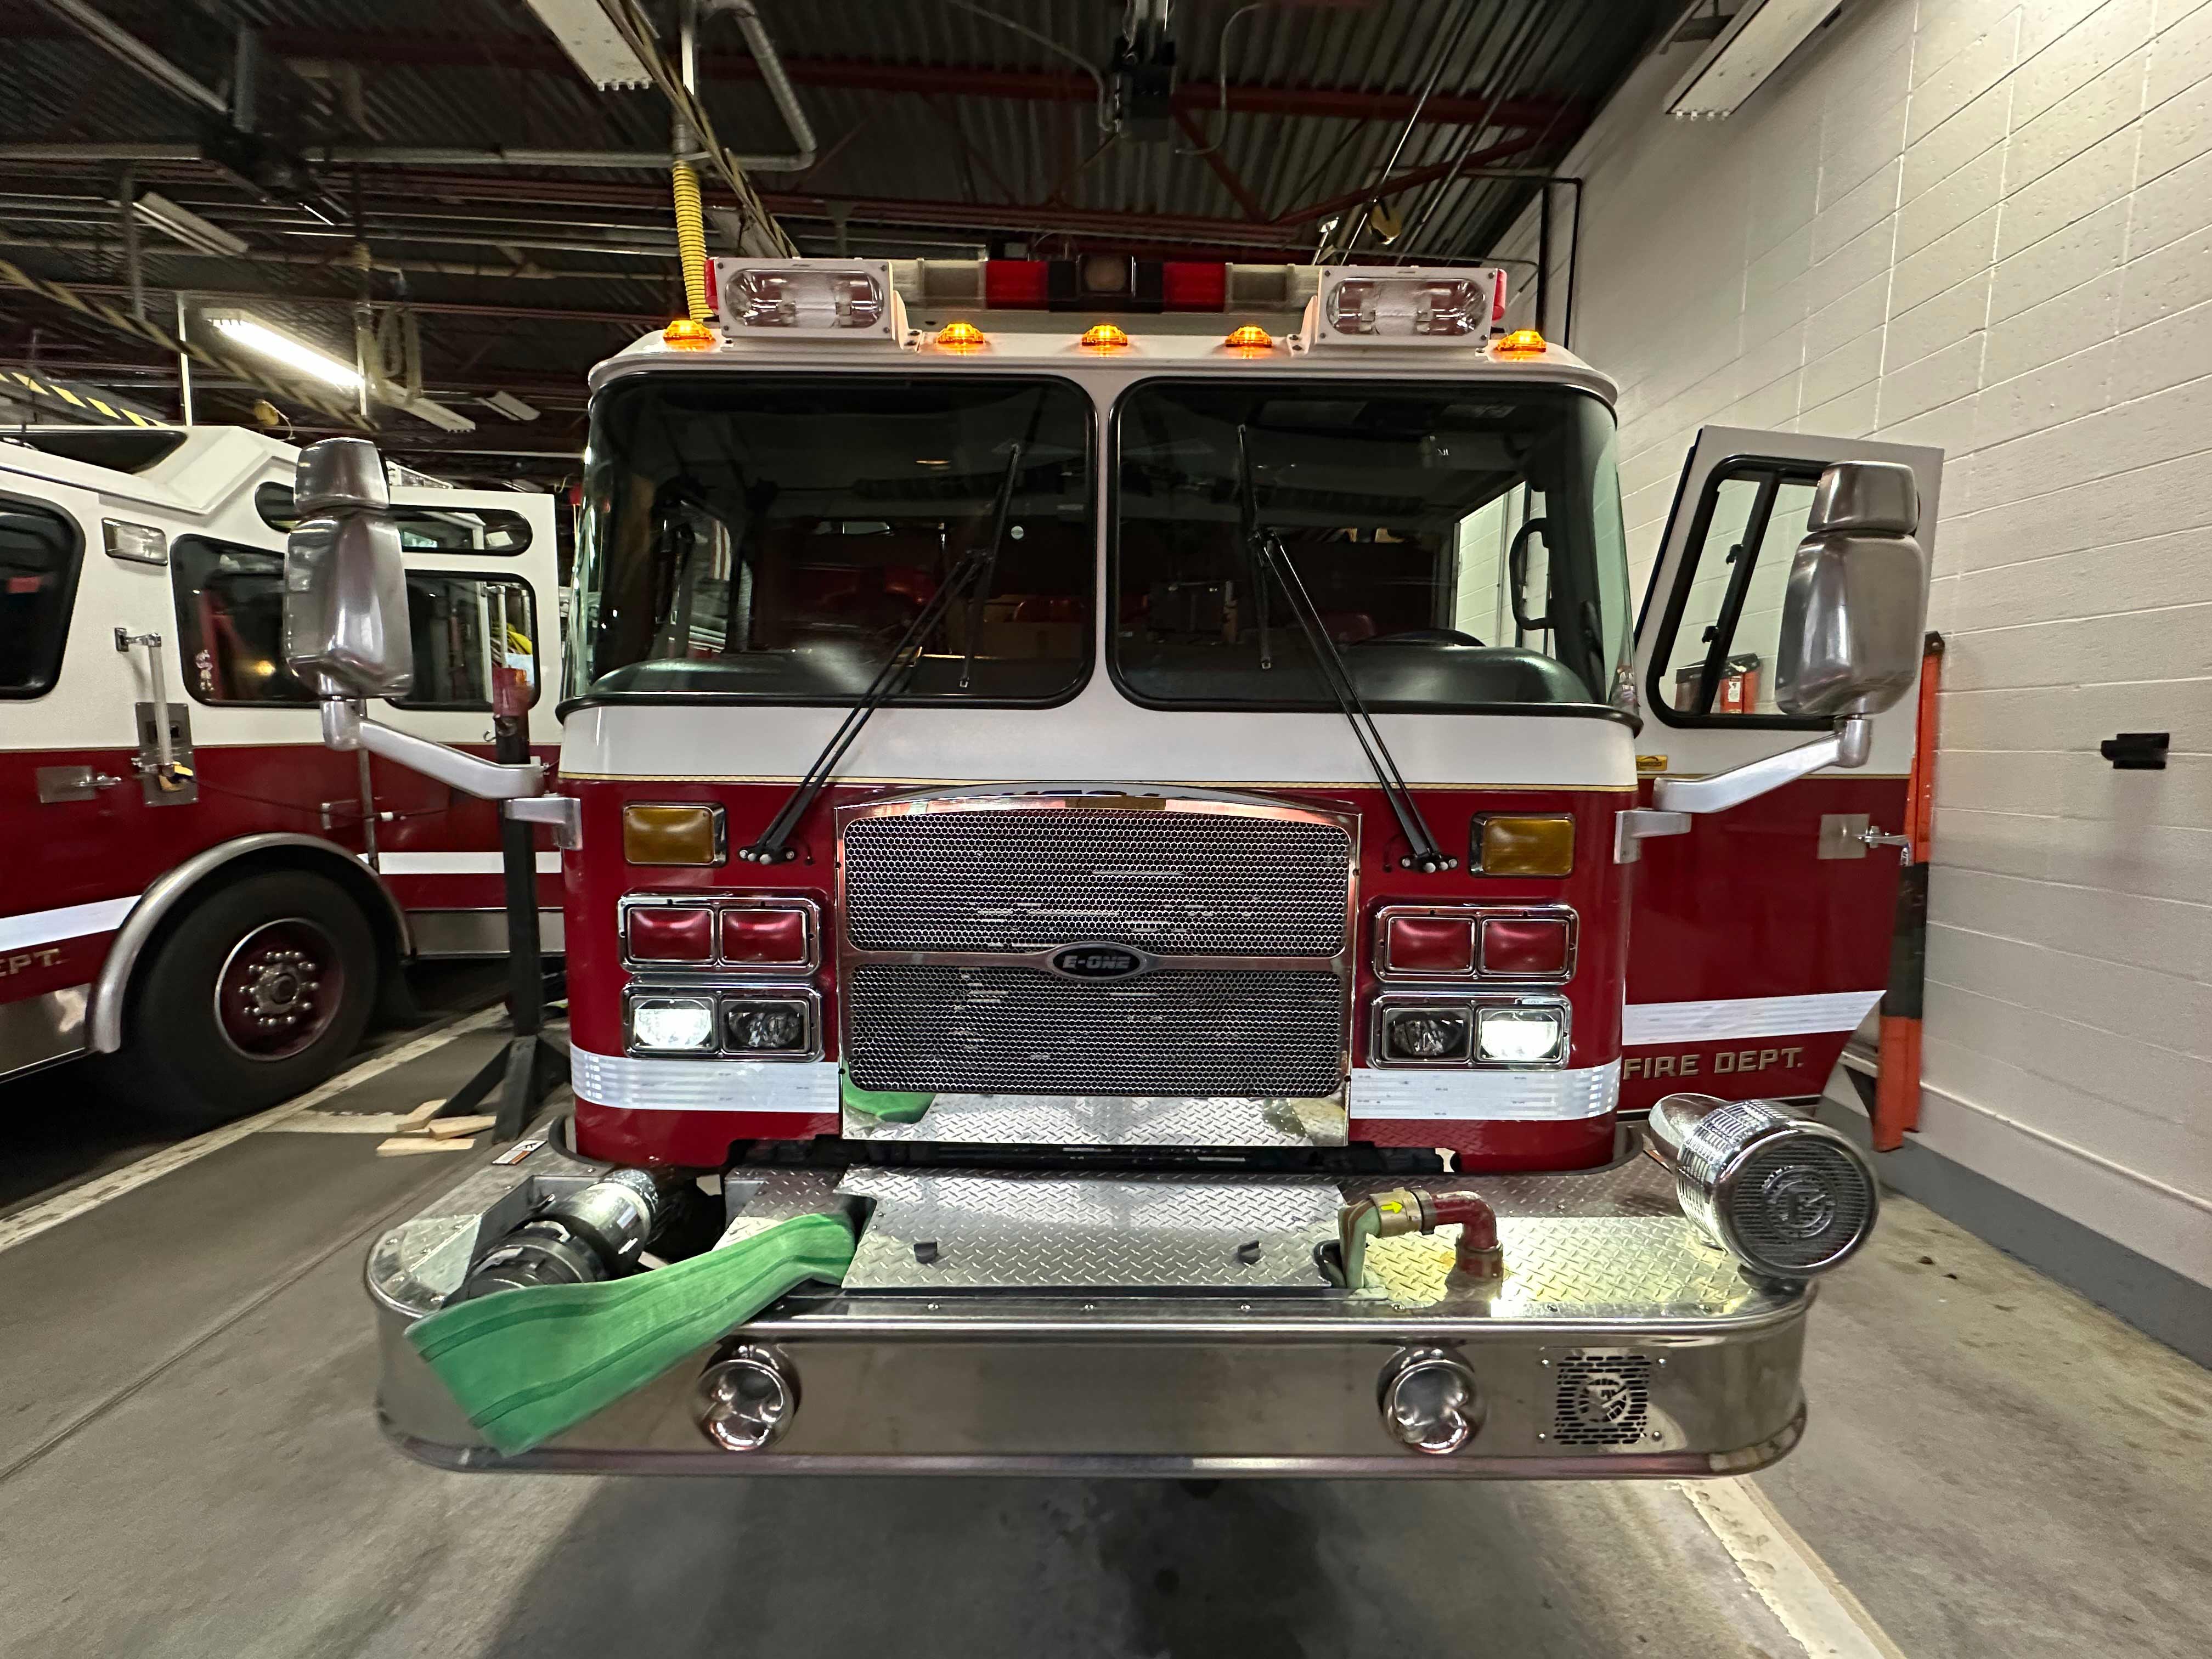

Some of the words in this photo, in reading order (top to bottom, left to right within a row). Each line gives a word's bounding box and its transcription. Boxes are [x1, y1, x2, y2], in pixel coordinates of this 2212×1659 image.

[1063, 955, 1131, 969] E-ONE
[1623, 1054, 1701, 1080] FIRE
[1714, 1047, 1804, 1074] DEPT.
